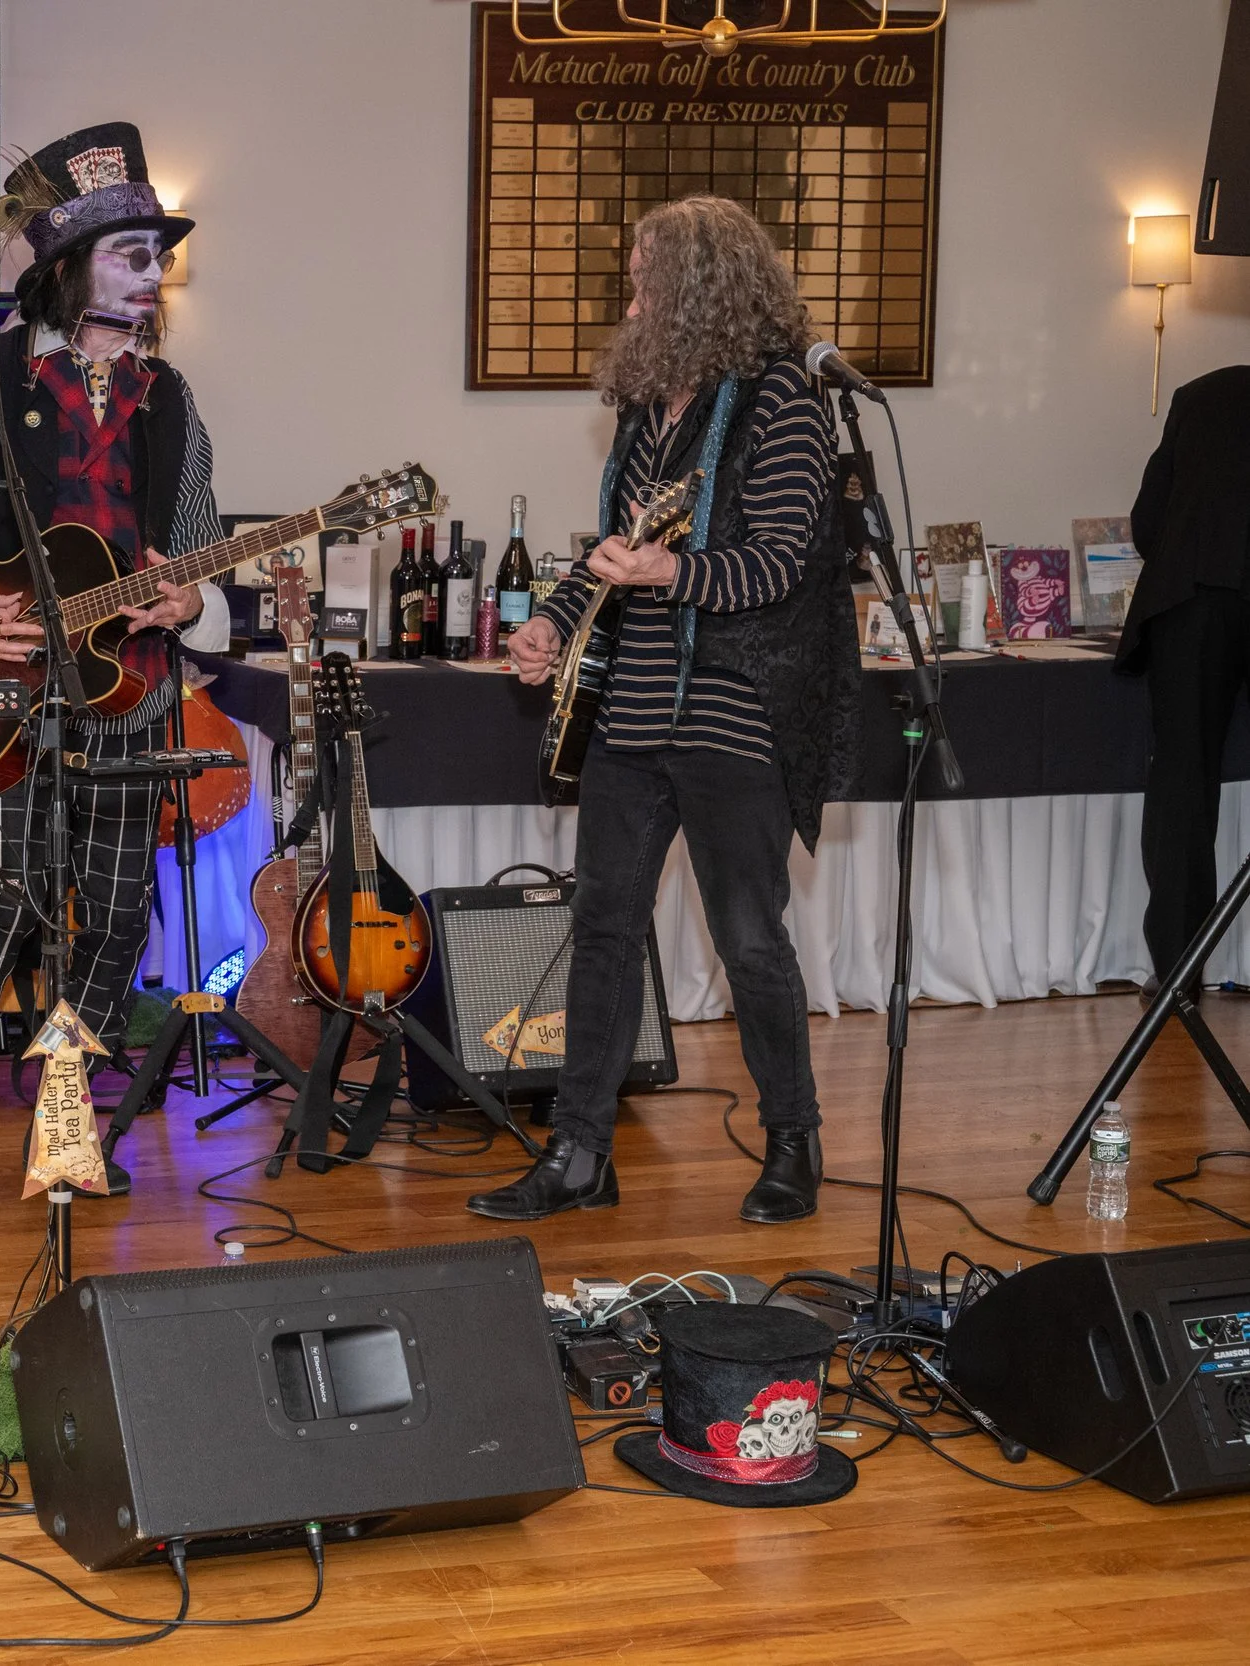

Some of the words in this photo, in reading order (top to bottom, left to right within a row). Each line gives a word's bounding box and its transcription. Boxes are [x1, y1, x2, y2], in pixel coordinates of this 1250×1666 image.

[508, 51, 650, 85] Metuchen
[657, 52, 713, 98] Golf
[716, 52, 742, 87] &
[746, 53, 847, 97] Country
[854, 53, 916, 87] Club
[575, 100, 654, 122] CLUB
[662, 102, 848, 123] PRESIDENTS
[412, 475, 428, 502] GRETSCH
[335, 615, 358, 624] BOBA
[58, 1060, 83, 1110] Party
[62, 1116, 81, 1151] Tea
[1213, 1348, 1250, 1360] SAMSON
[313, 1355, 327, 1403] Electro-Voice
